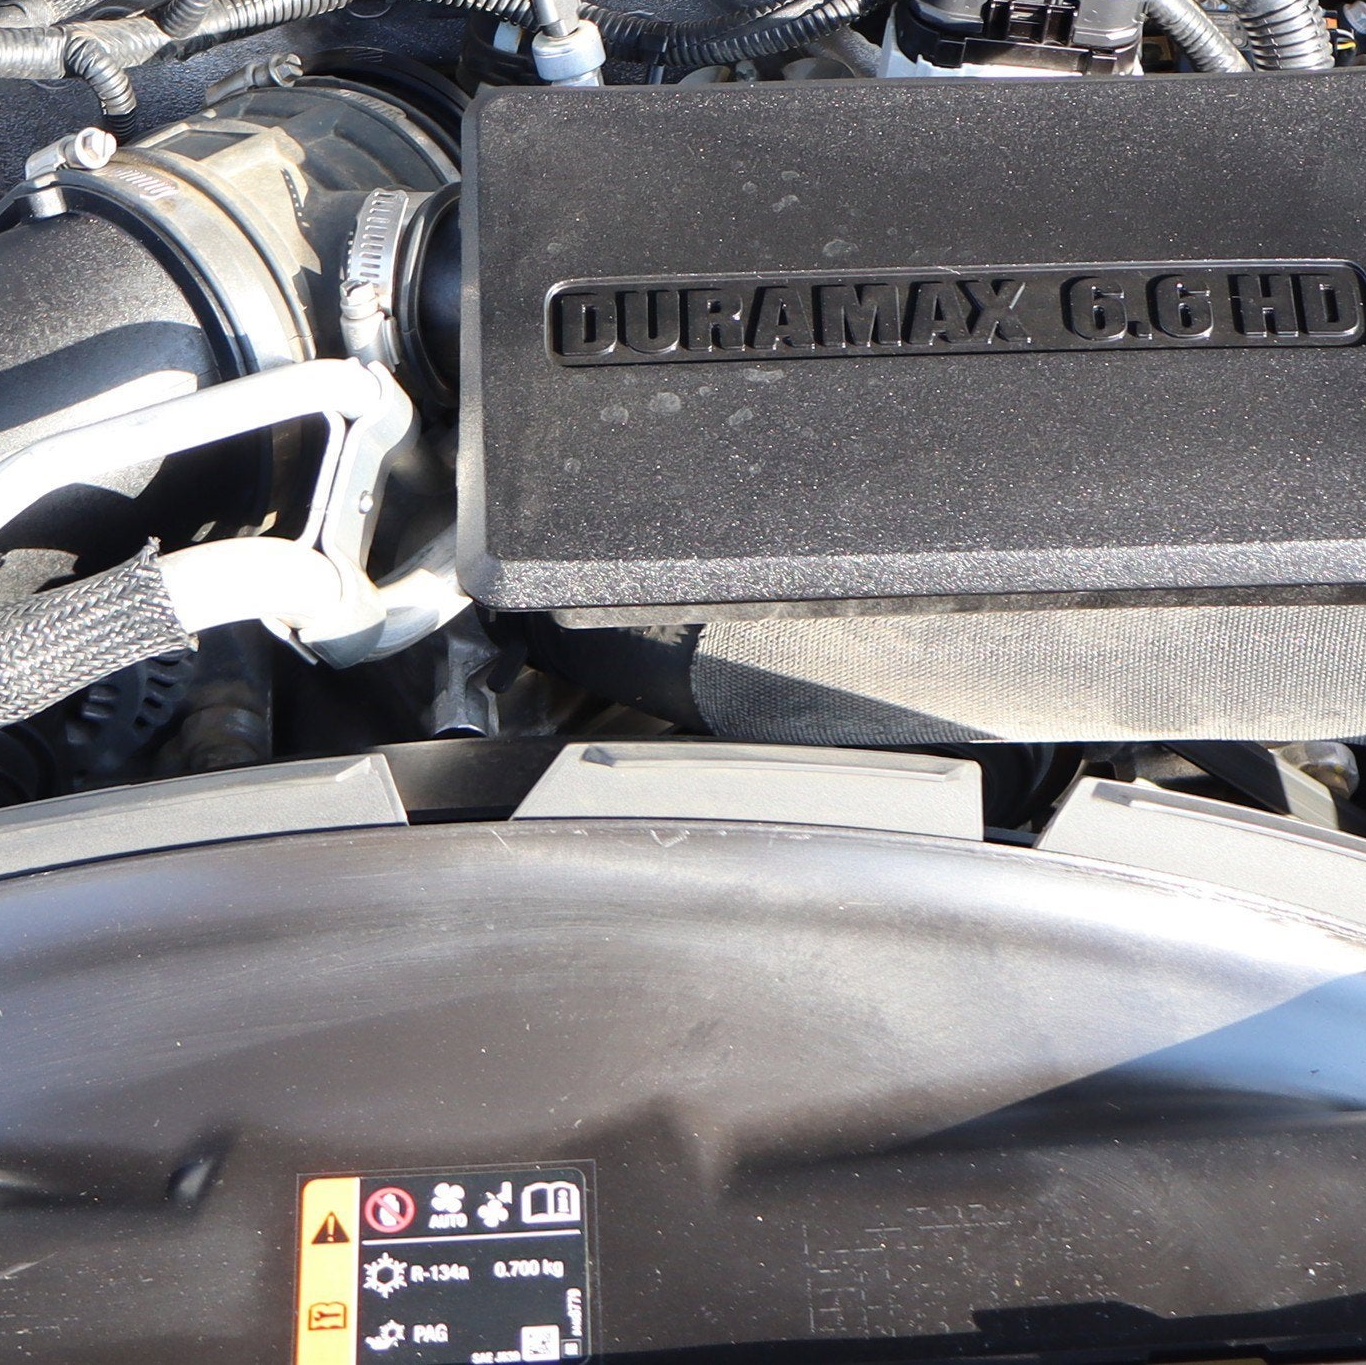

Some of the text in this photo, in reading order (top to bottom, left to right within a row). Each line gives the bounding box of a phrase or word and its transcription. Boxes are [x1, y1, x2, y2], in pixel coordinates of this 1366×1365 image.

[558, 272, 1365, 358] DURAMAX 6.6 HD
[429, 1212, 469, 1230] AUTO
[410, 1258, 565, 1282] R-134a 0.700 kg
[412, 1323, 449, 1344] PAG
